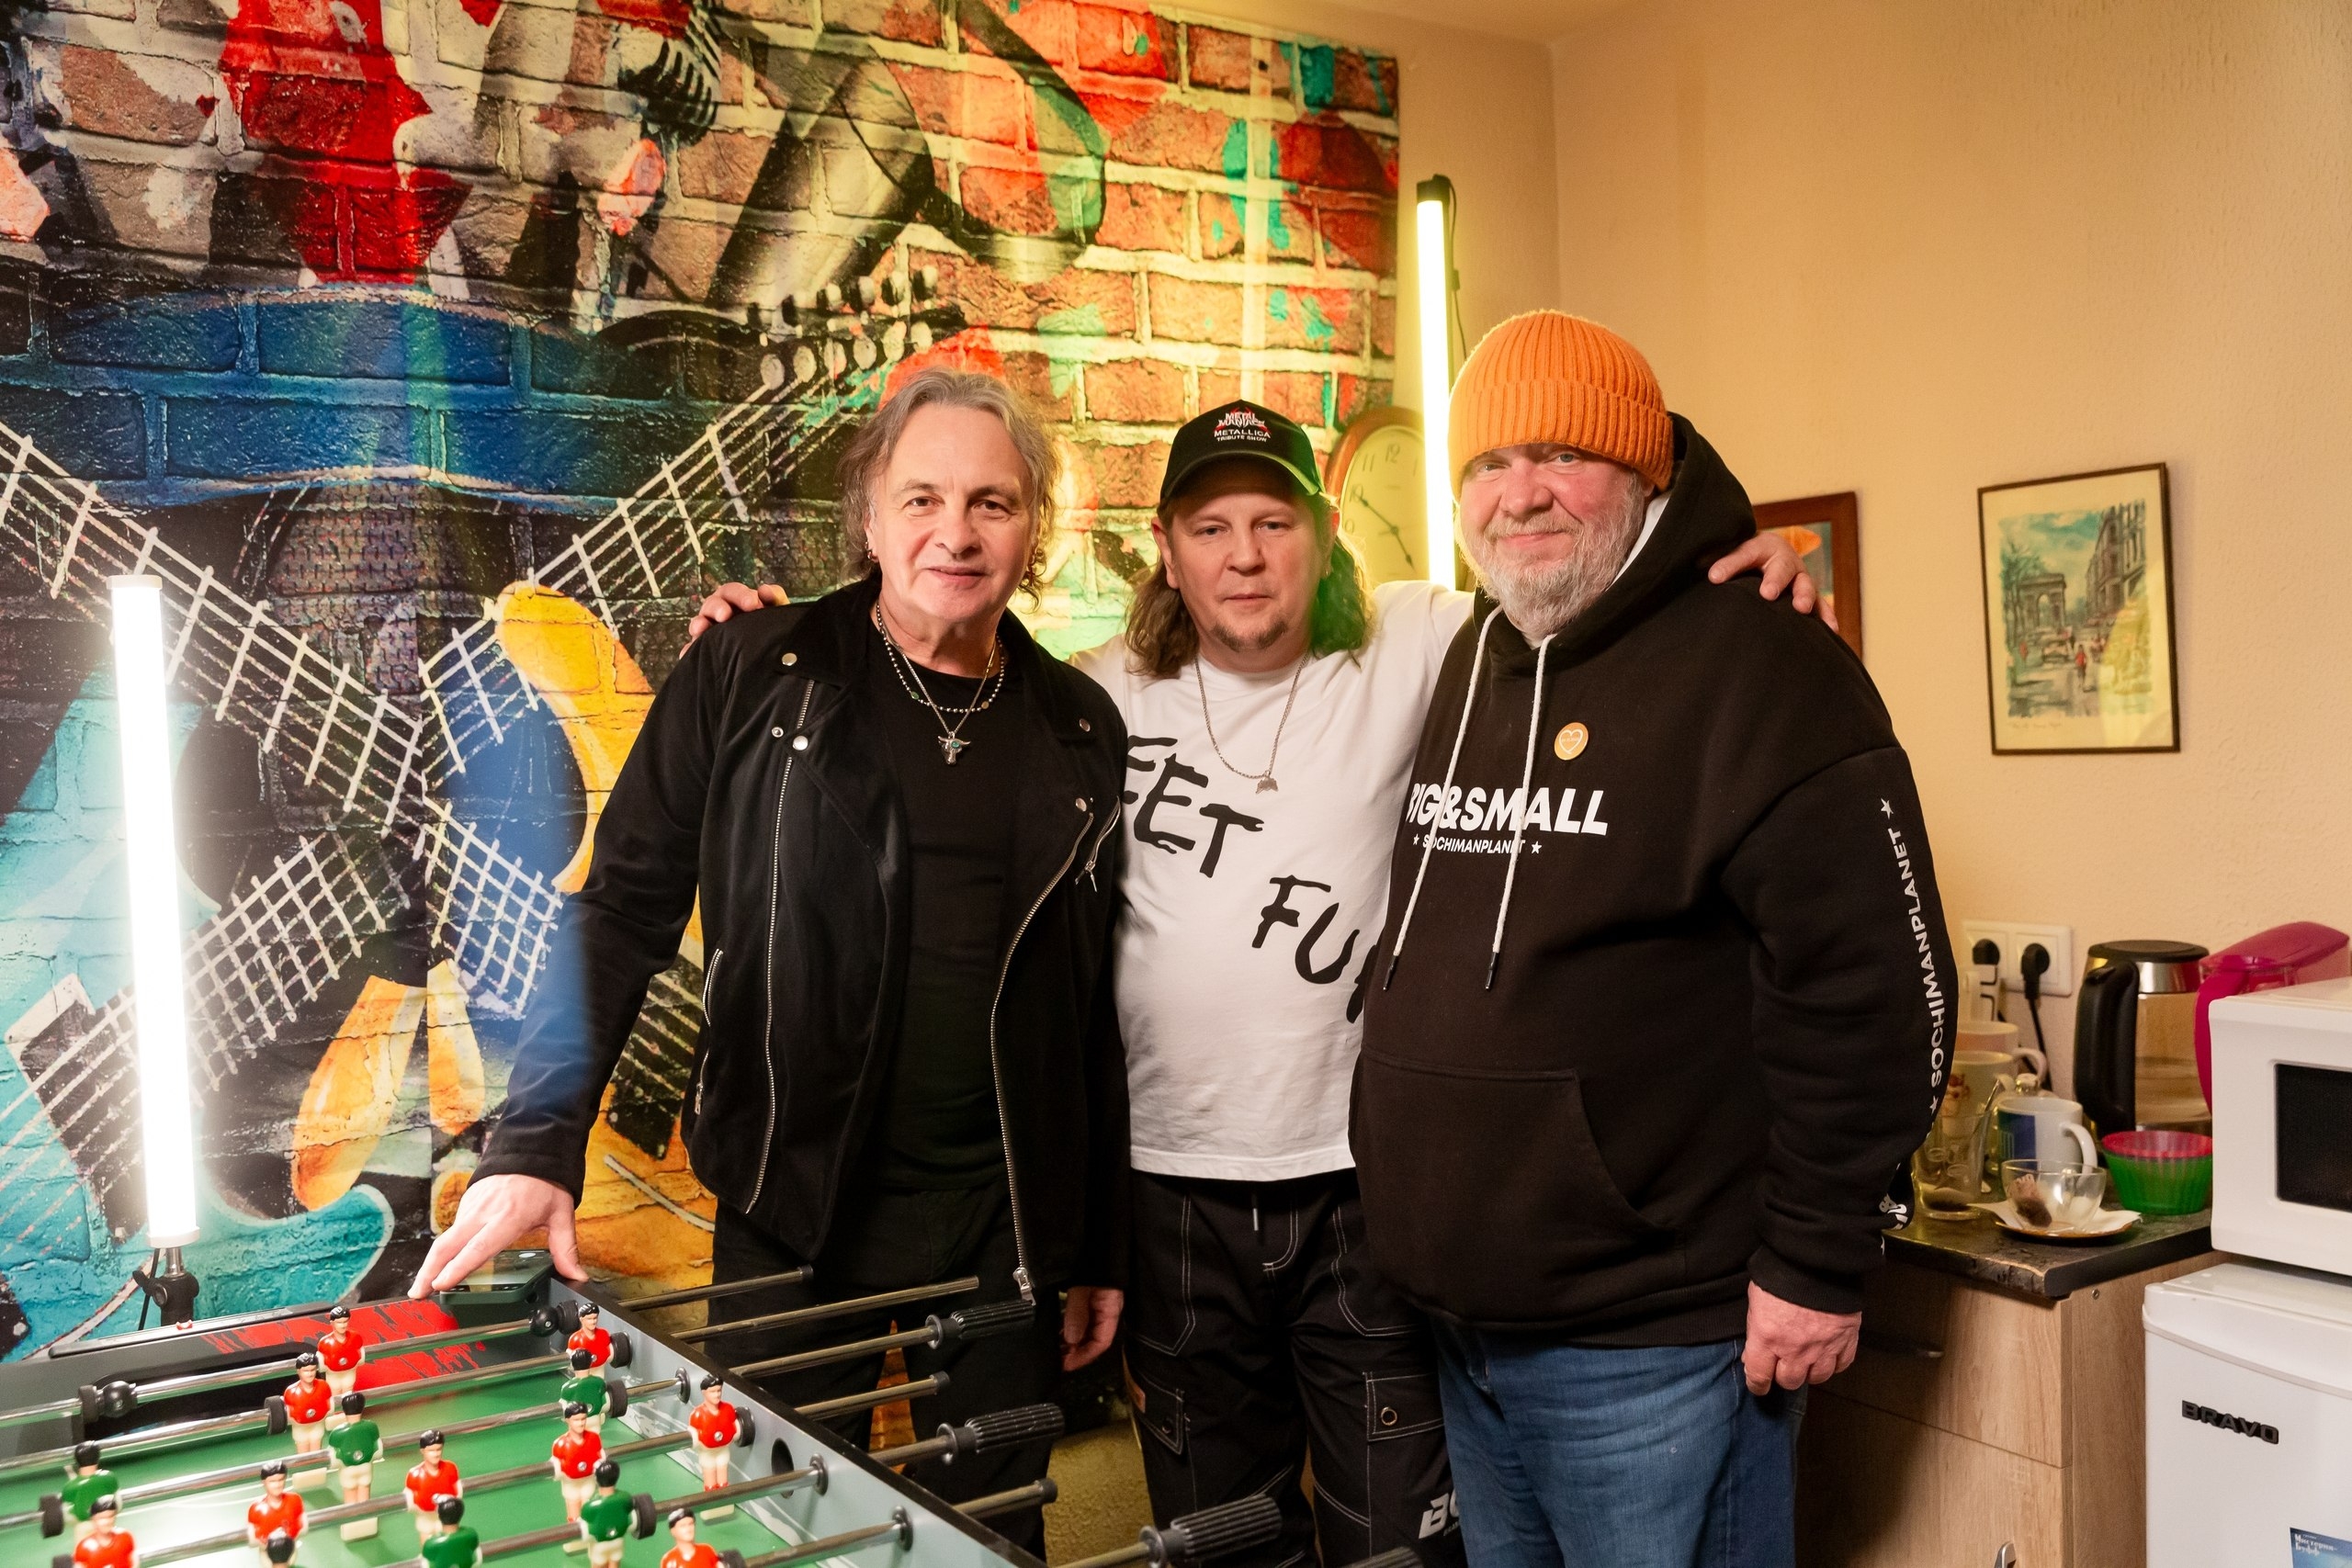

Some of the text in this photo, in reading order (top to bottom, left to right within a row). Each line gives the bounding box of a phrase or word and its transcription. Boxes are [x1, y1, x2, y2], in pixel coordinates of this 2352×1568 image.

[1225, 411, 1256, 423] METAL
[1214, 429, 1272, 439] METALLICA
[1385, 443, 1401, 463] 12
[1363, 455, 1374, 472] 11
[1350, 484, 1363, 502] 10
[1422, 834, 1526, 854] SCHIMANPLANT
[1888, 828, 1945, 1089] SOCHIMANPLANET
[2182, 1399, 2279, 1445] BRAVO
